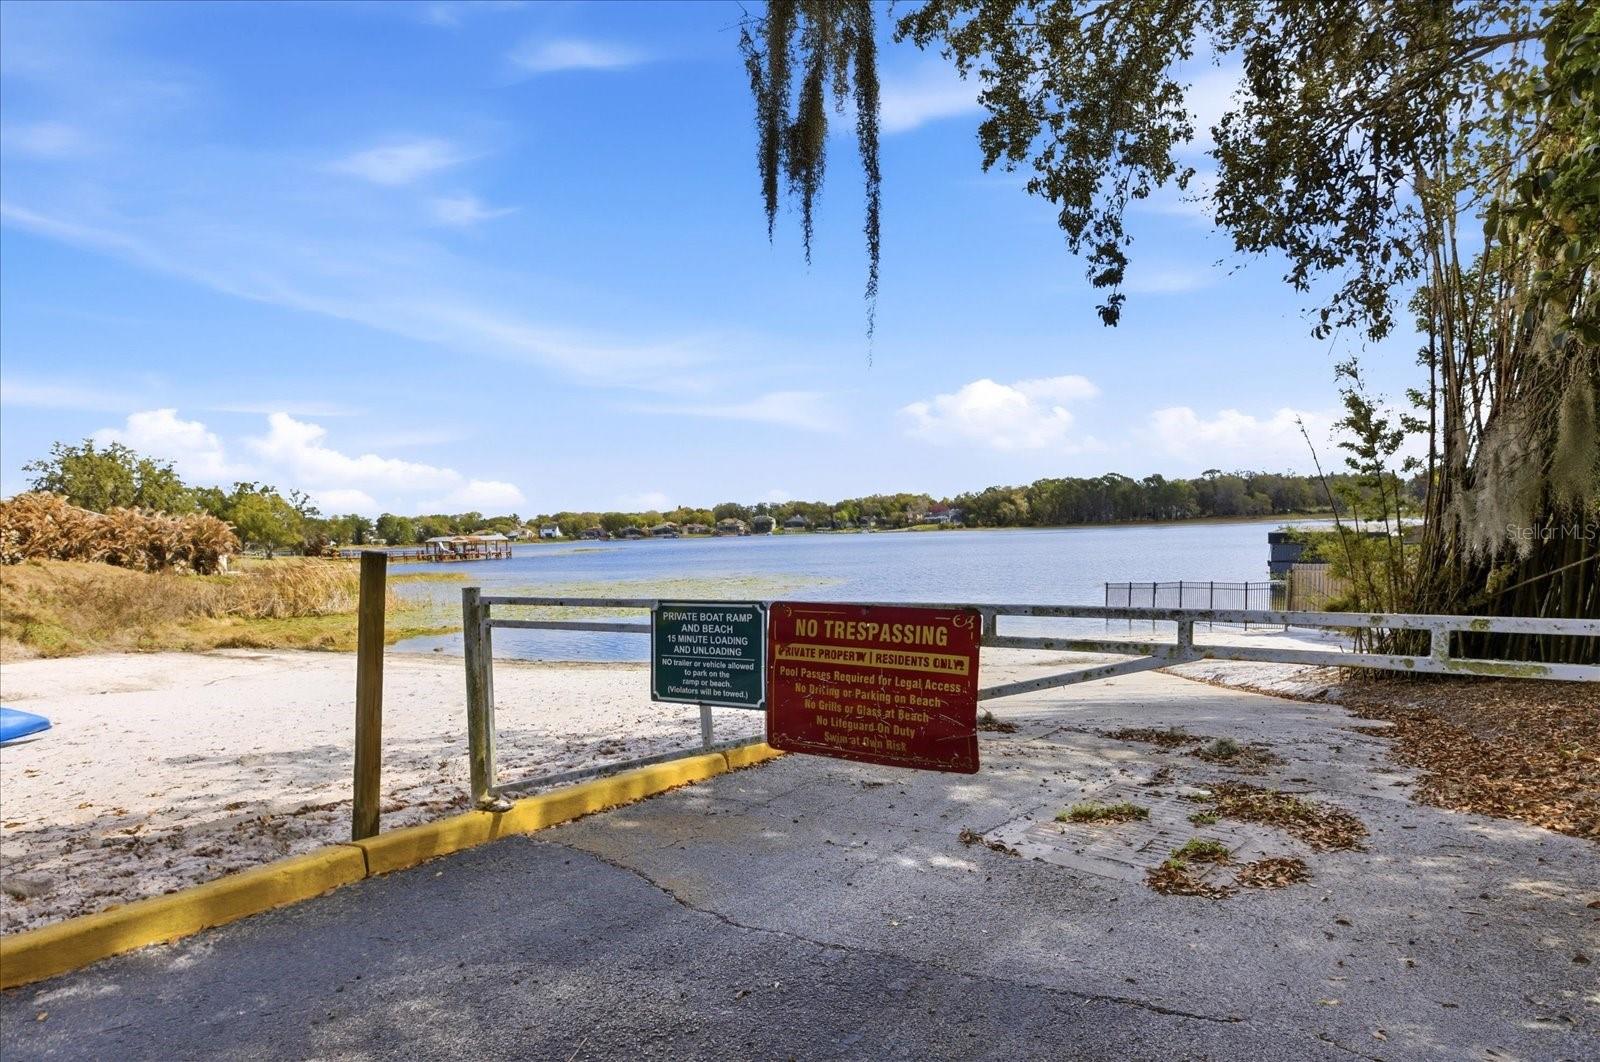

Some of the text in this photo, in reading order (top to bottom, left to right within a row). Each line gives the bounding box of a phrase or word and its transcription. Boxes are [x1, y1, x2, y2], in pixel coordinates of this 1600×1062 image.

[662, 612, 753, 622] PRIVATE BOAT RAMP
[681, 624, 734, 634] AND BEACH
[796, 619, 948, 646] NO TRESPASSING
[667, 634, 748, 646] 15 MINUTE LOADING
[673, 646, 742, 656] AND UNLOADING
[778, 646, 866, 662] PRIVATE PROPERTY
[674, 660, 692, 668] trailer
[728, 662, 754, 670] allowed
[876, 654, 930, 668] RESIDENTS
[692, 670, 708, 678] park
[780, 666, 962, 692] Pool Passes Required for Legal Access
[667, 686, 698, 694] (Violators
[700, 688, 712, 696] will
[723, 690, 748, 700] towed.)
[795, 682, 806, 692] No
[843, 688, 853, 698] or
[855, 688, 891, 704] Parking
[894, 694, 906, 703] on
[910, 694, 941, 707] Beach
[804, 698, 928, 722] No Grills or Glass at Beach
[816, 715, 916, 739] No Lifeguard On Duty
[824, 731, 907, 752] Swim at Own Risk
